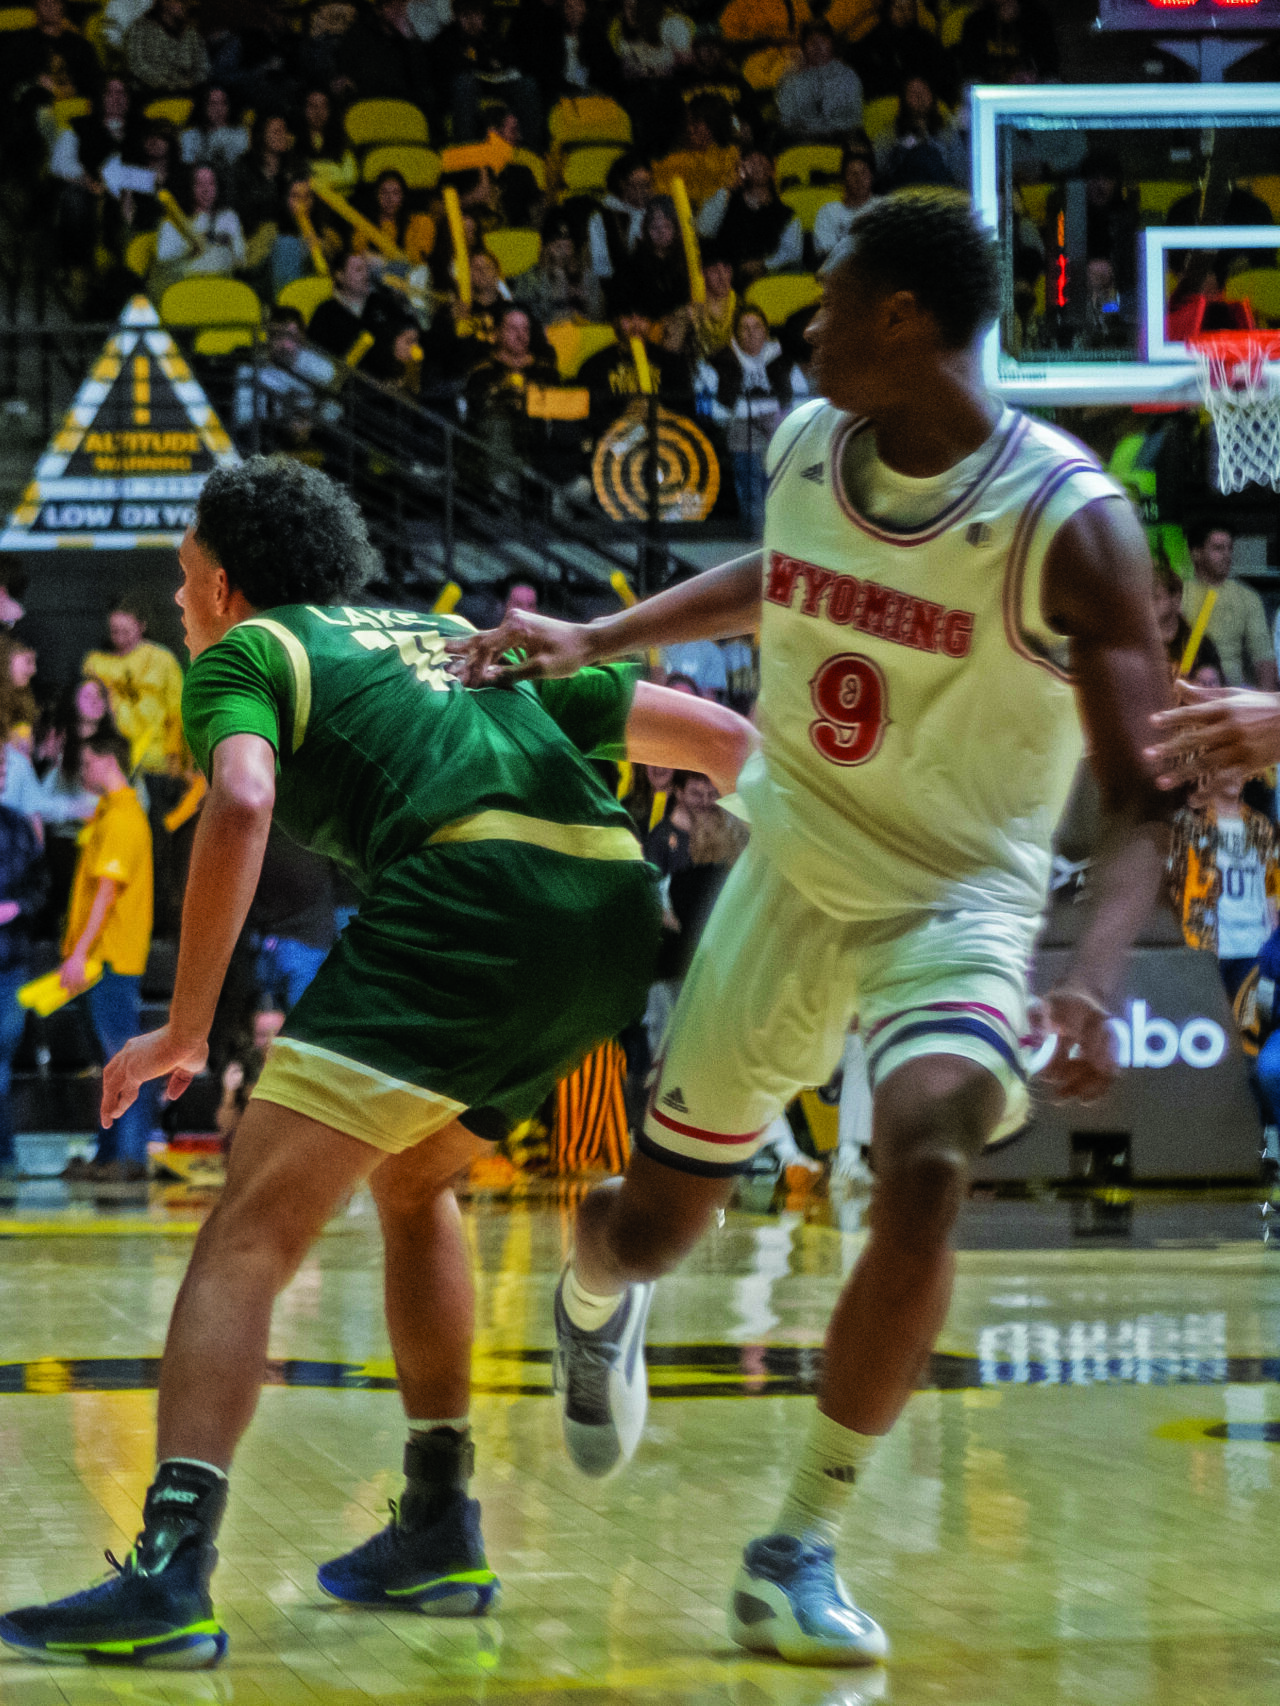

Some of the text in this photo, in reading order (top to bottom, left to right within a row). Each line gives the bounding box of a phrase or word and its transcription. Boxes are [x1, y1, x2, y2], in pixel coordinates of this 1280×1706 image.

[44, 504, 114, 529] LOW
[764, 549, 976, 659] WYOMING
[808, 652, 895, 767] 9
